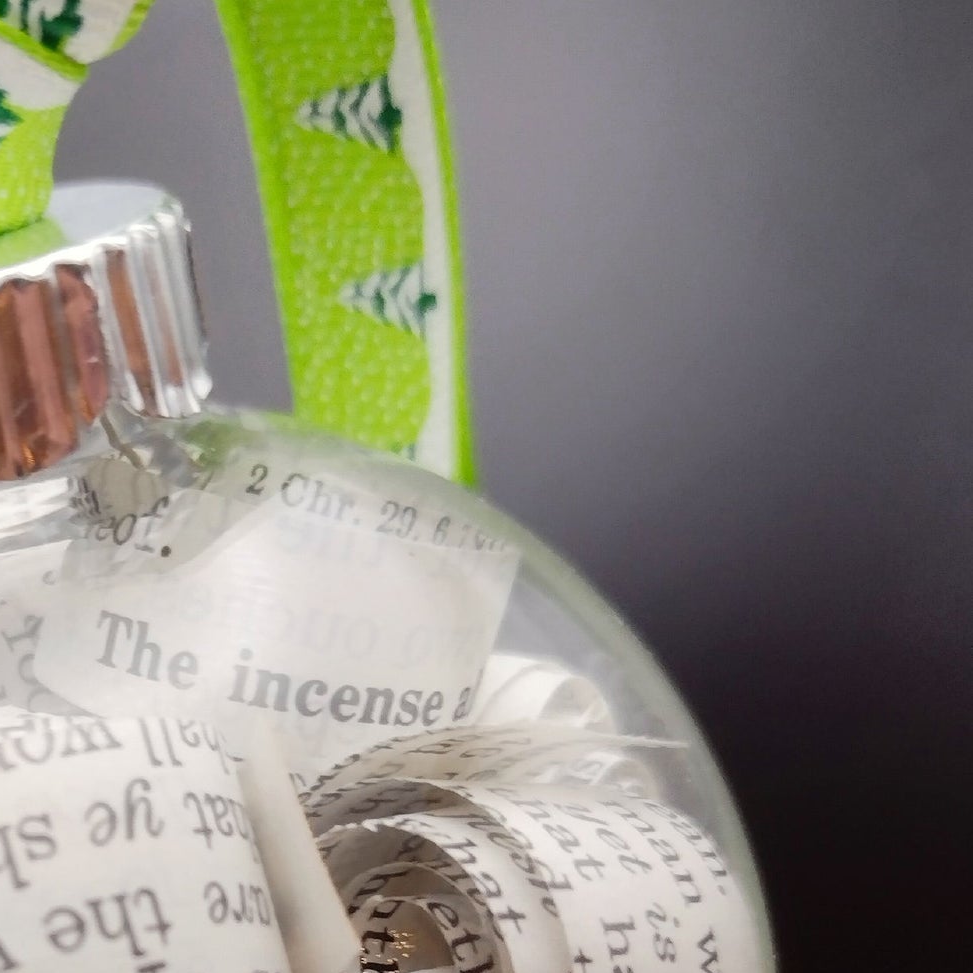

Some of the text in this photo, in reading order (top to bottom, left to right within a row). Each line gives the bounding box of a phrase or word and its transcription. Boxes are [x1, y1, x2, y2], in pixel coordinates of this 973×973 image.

[245, 463, 269, 496] 2
[95, 608, 200, 691] The
[227, 647, 444, 728] incense
[85, 777, 165, 848] ye
[43, 886, 174, 959] the
[645, 902, 681, 964] is
